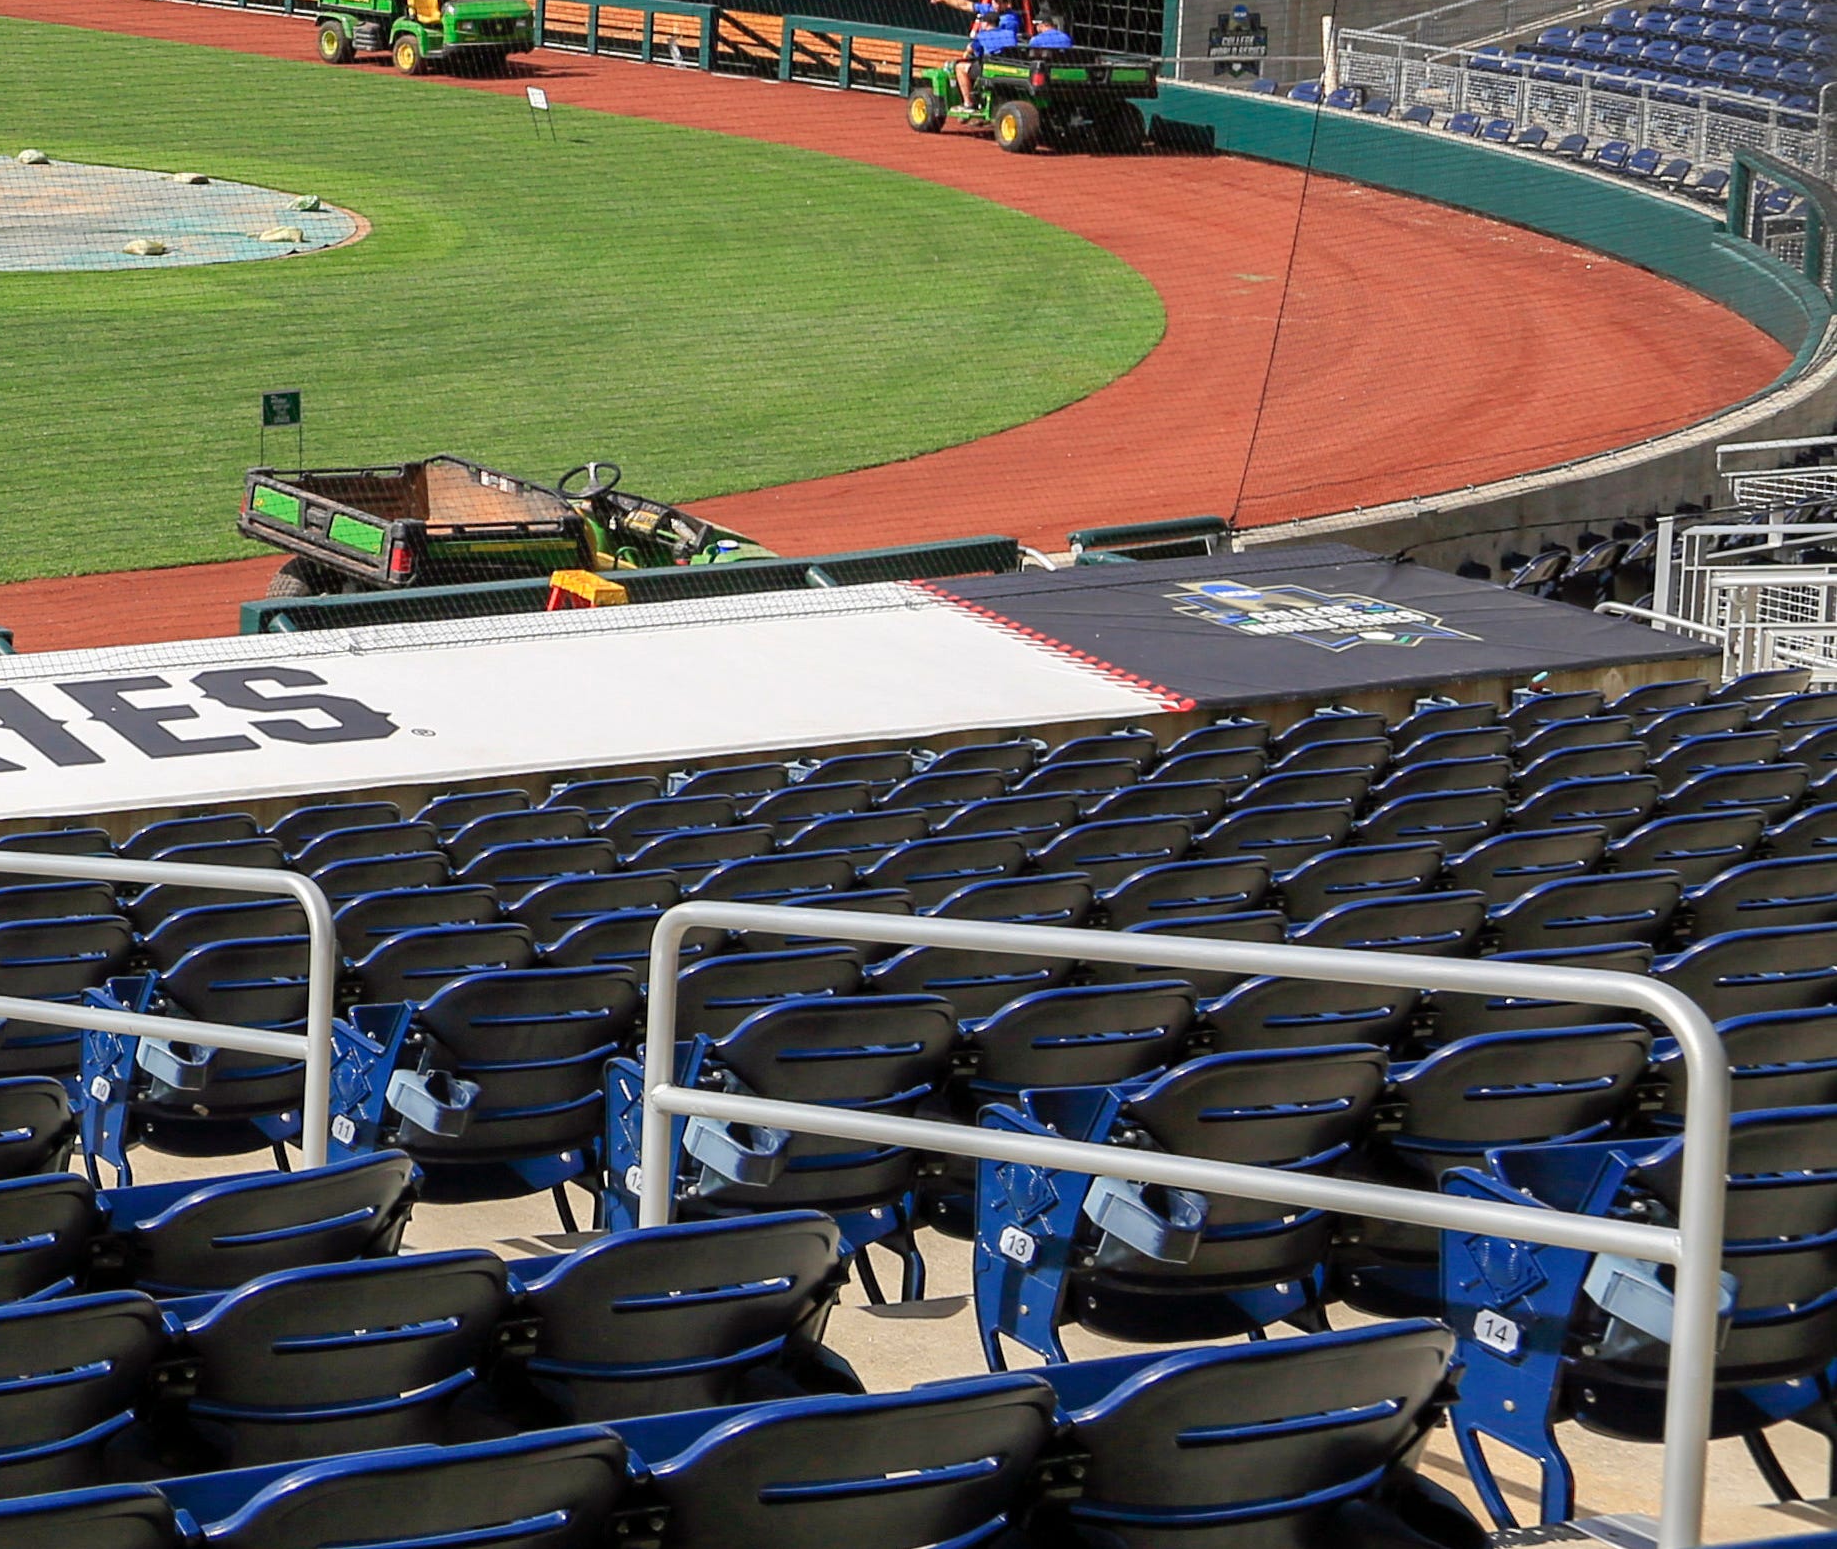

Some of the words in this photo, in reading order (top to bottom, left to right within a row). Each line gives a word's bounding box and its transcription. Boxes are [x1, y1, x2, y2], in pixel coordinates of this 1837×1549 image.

[1239, 616, 1338, 636] WORLD
[1331, 611, 1427, 628] SERIES
[1248, 604, 1362, 622] COLLEGE
[96, 1081, 108, 1098] 10
[337, 1120, 351, 1139] 11
[1008, 1234, 1027, 1257] 13
[1483, 1318, 1507, 1344] 14
